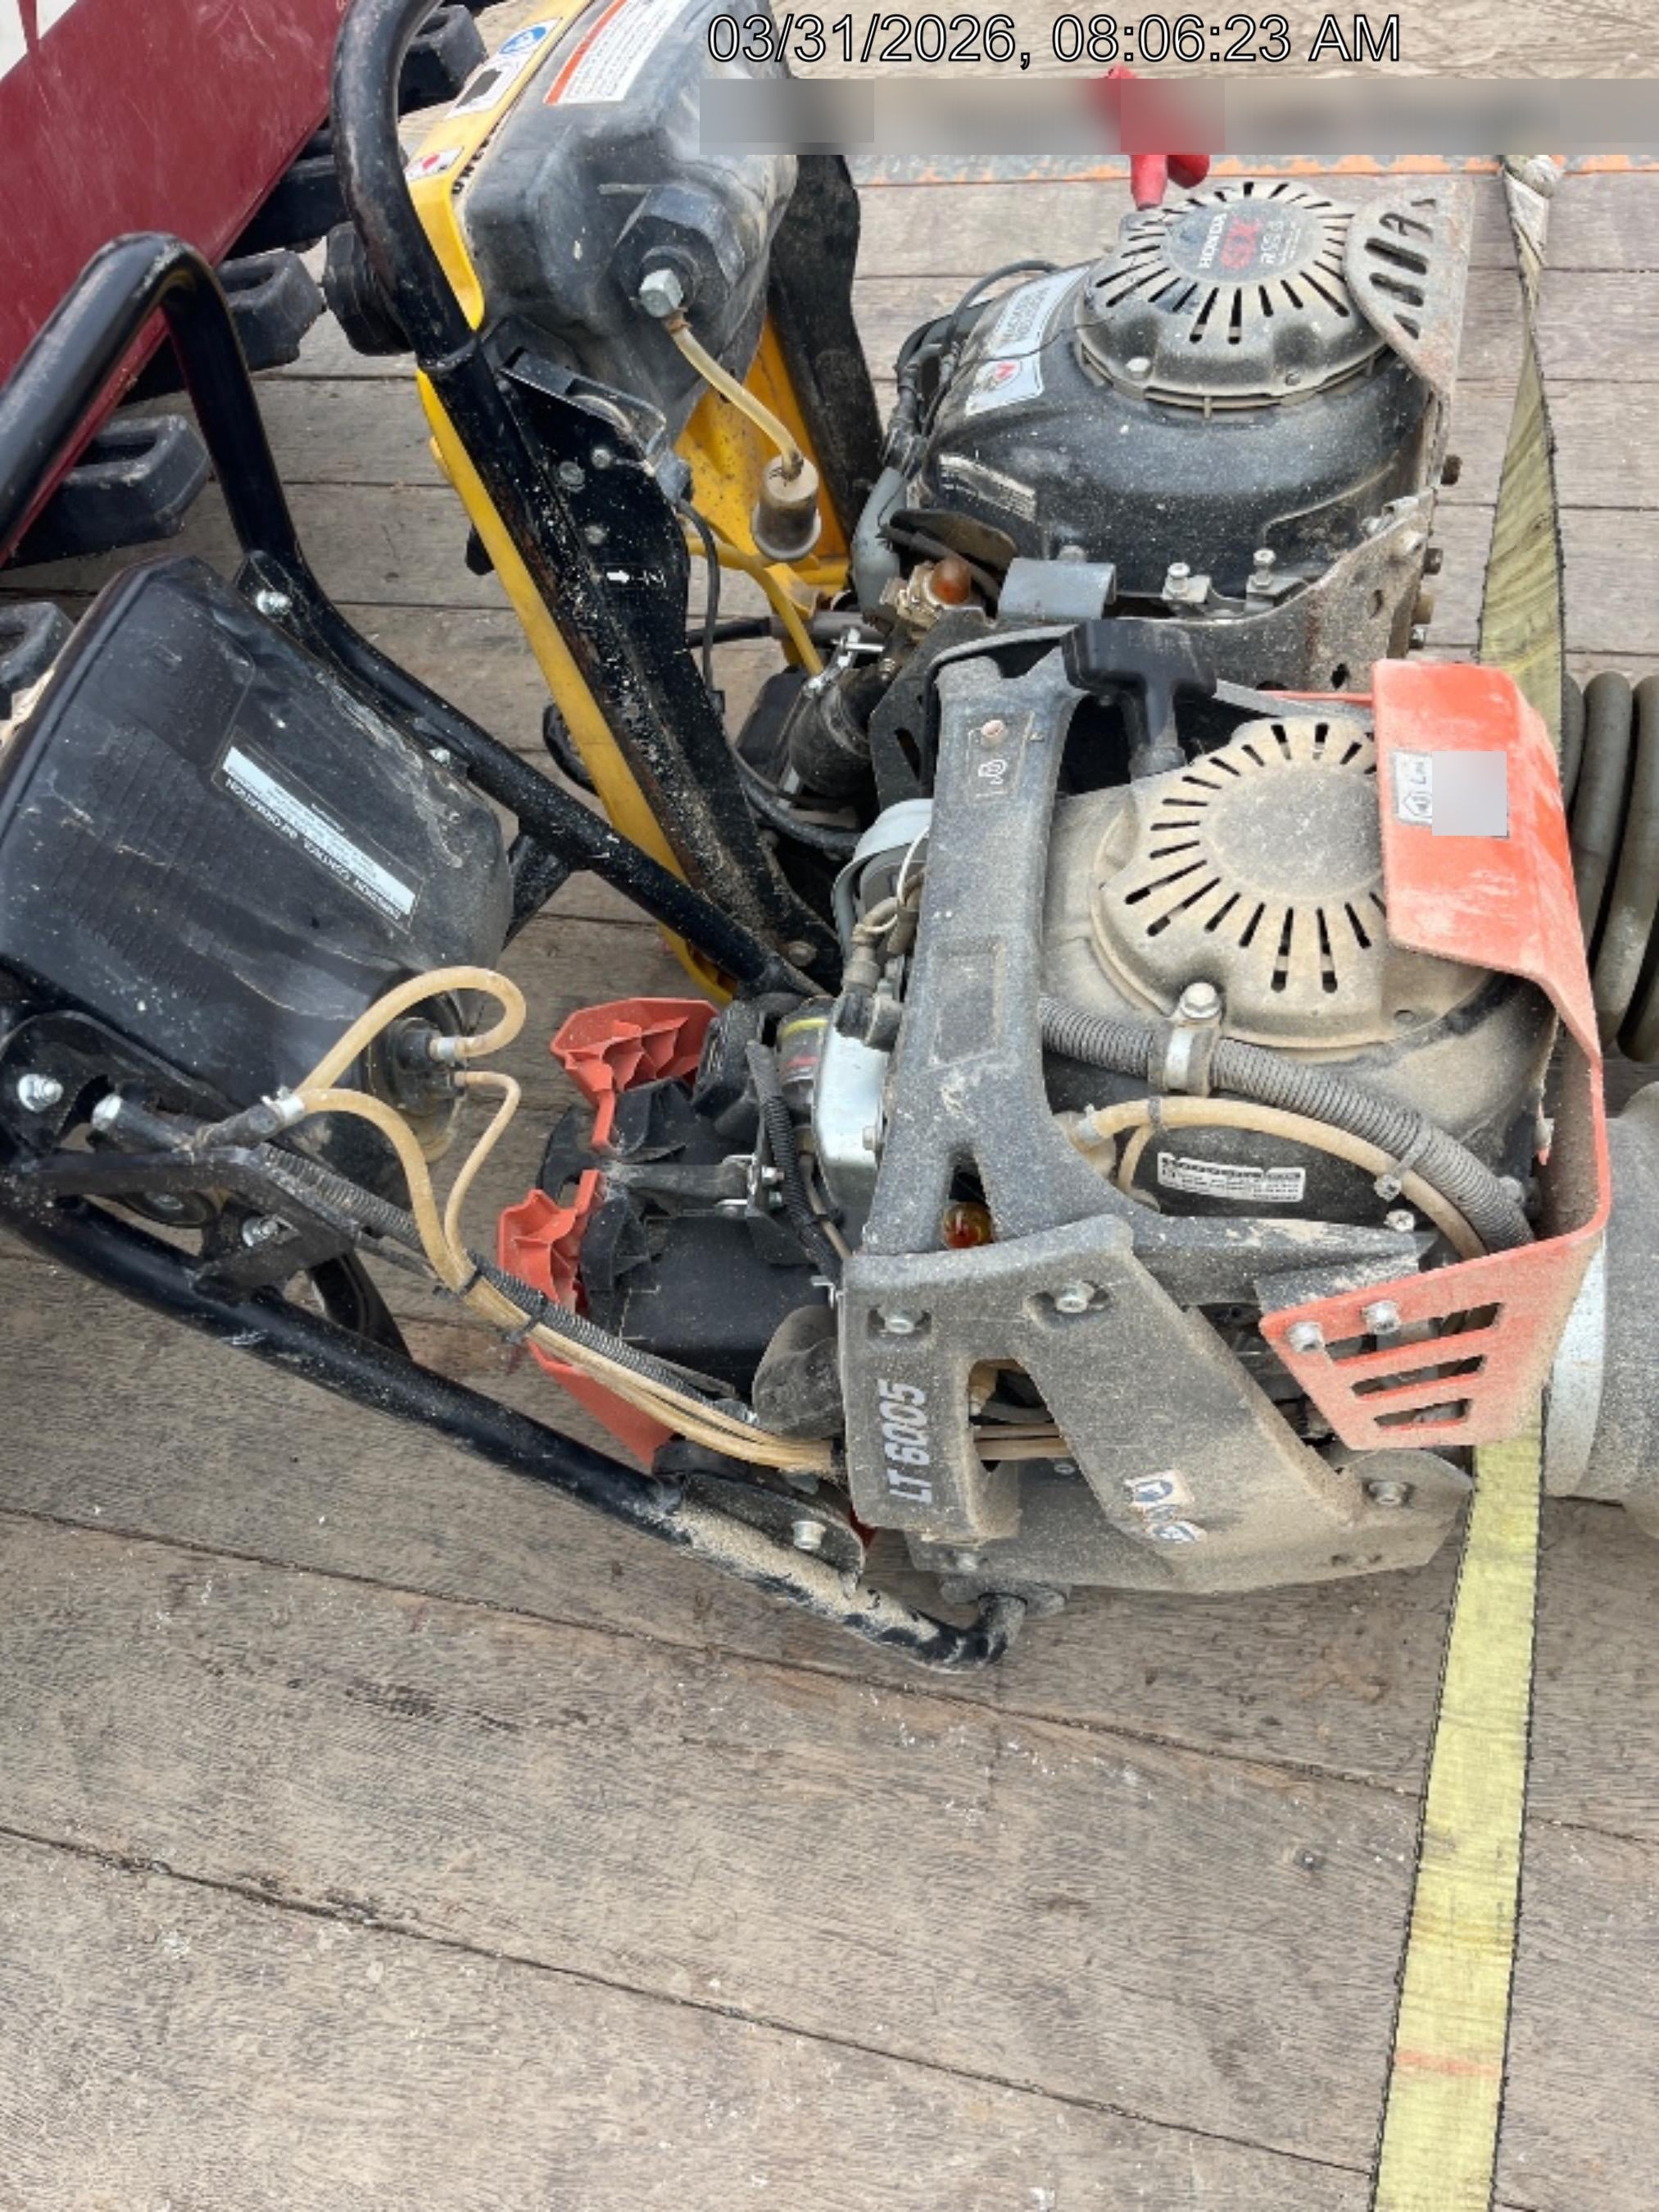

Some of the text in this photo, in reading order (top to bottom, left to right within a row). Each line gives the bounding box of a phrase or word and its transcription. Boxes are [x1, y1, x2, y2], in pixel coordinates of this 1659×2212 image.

[1196, 213, 1227, 270] HONDA
[877, 1378, 932, 1503] LT 6005
